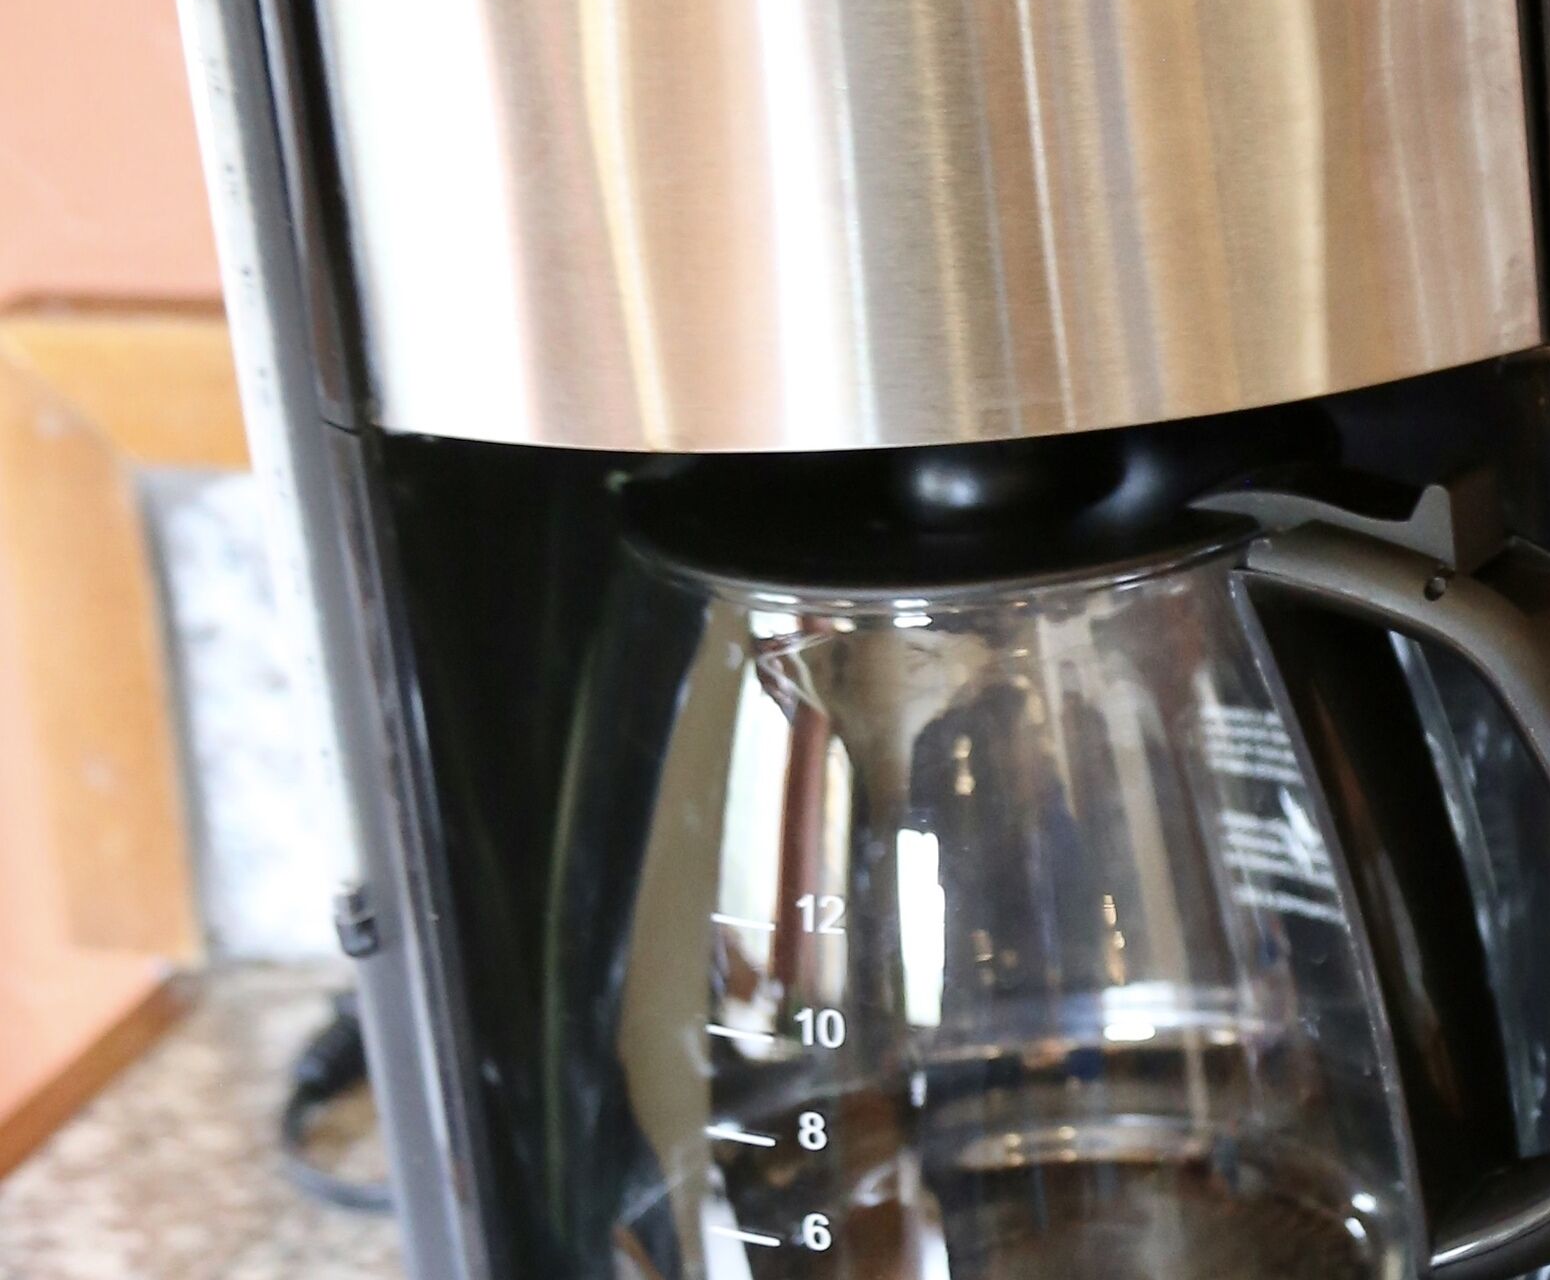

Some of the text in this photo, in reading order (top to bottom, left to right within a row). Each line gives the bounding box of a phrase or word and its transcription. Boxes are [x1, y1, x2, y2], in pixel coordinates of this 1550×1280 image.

[796, 895, 846, 934] 12
[795, 1008, 847, 1049] 10
[798, 1112, 828, 1151] 8
[802, 1213, 832, 1252] 6
